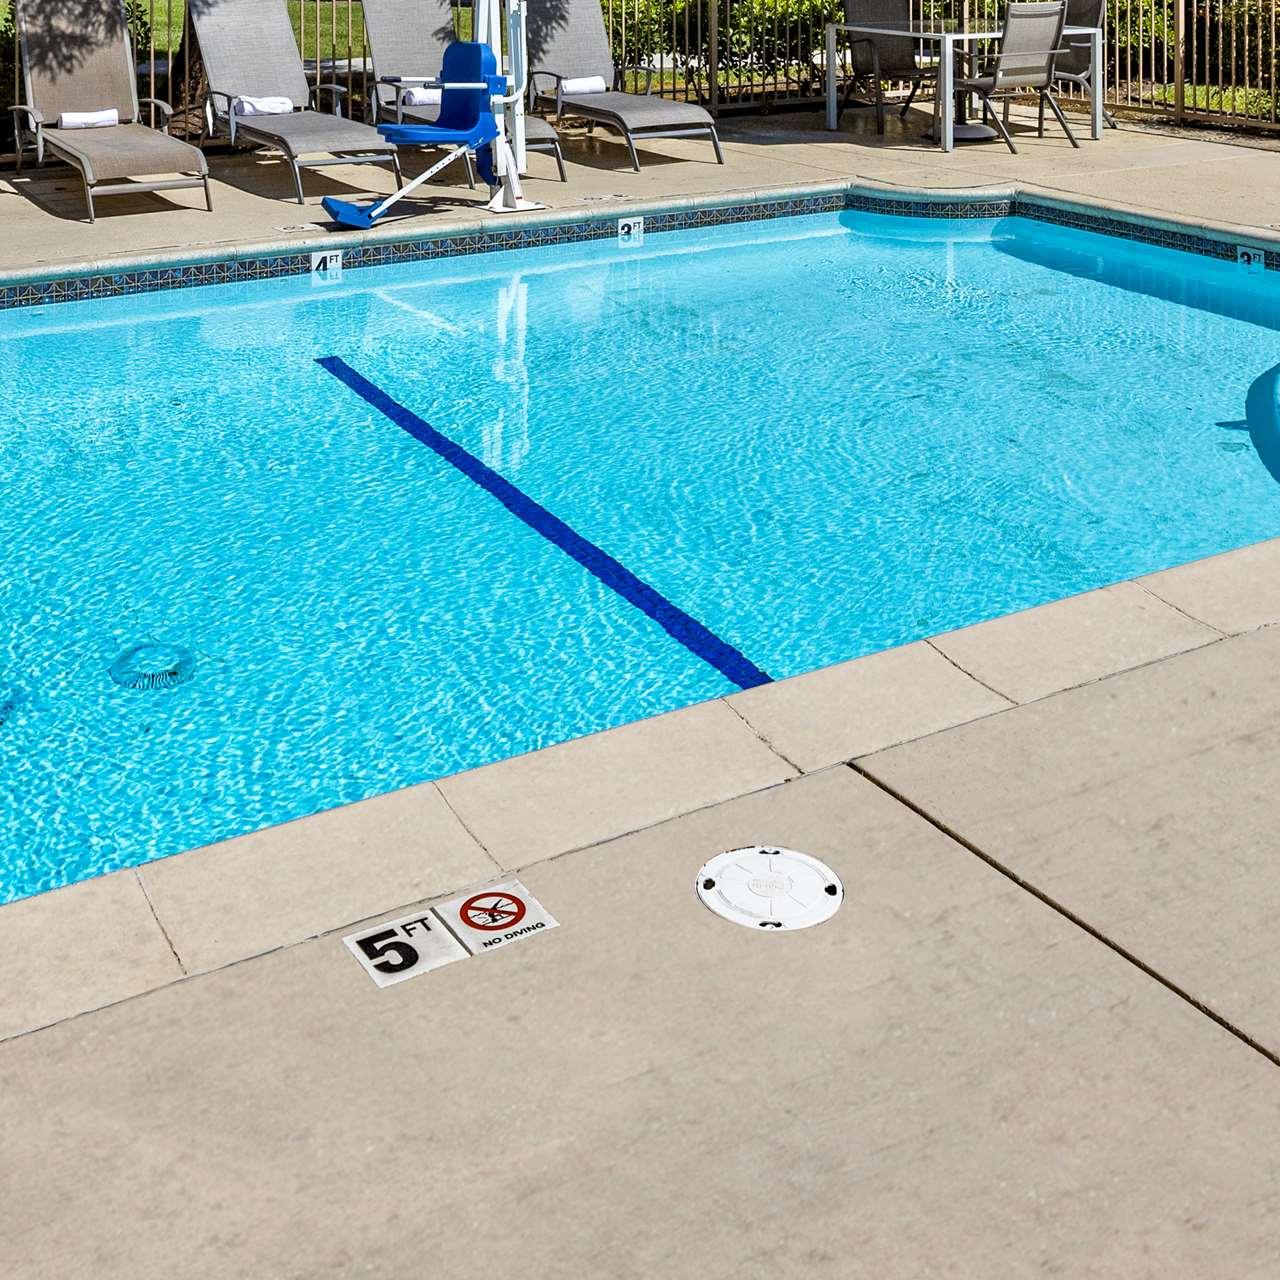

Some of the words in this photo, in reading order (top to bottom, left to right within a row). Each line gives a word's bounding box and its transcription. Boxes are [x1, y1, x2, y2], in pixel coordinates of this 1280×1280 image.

[330, 254, 340, 264] FT
[355, 928, 419, 974] 5
[400, 917, 433, 938] FT
[482, 937, 502, 948] NO
[504, 922, 546, 940] DIVING
